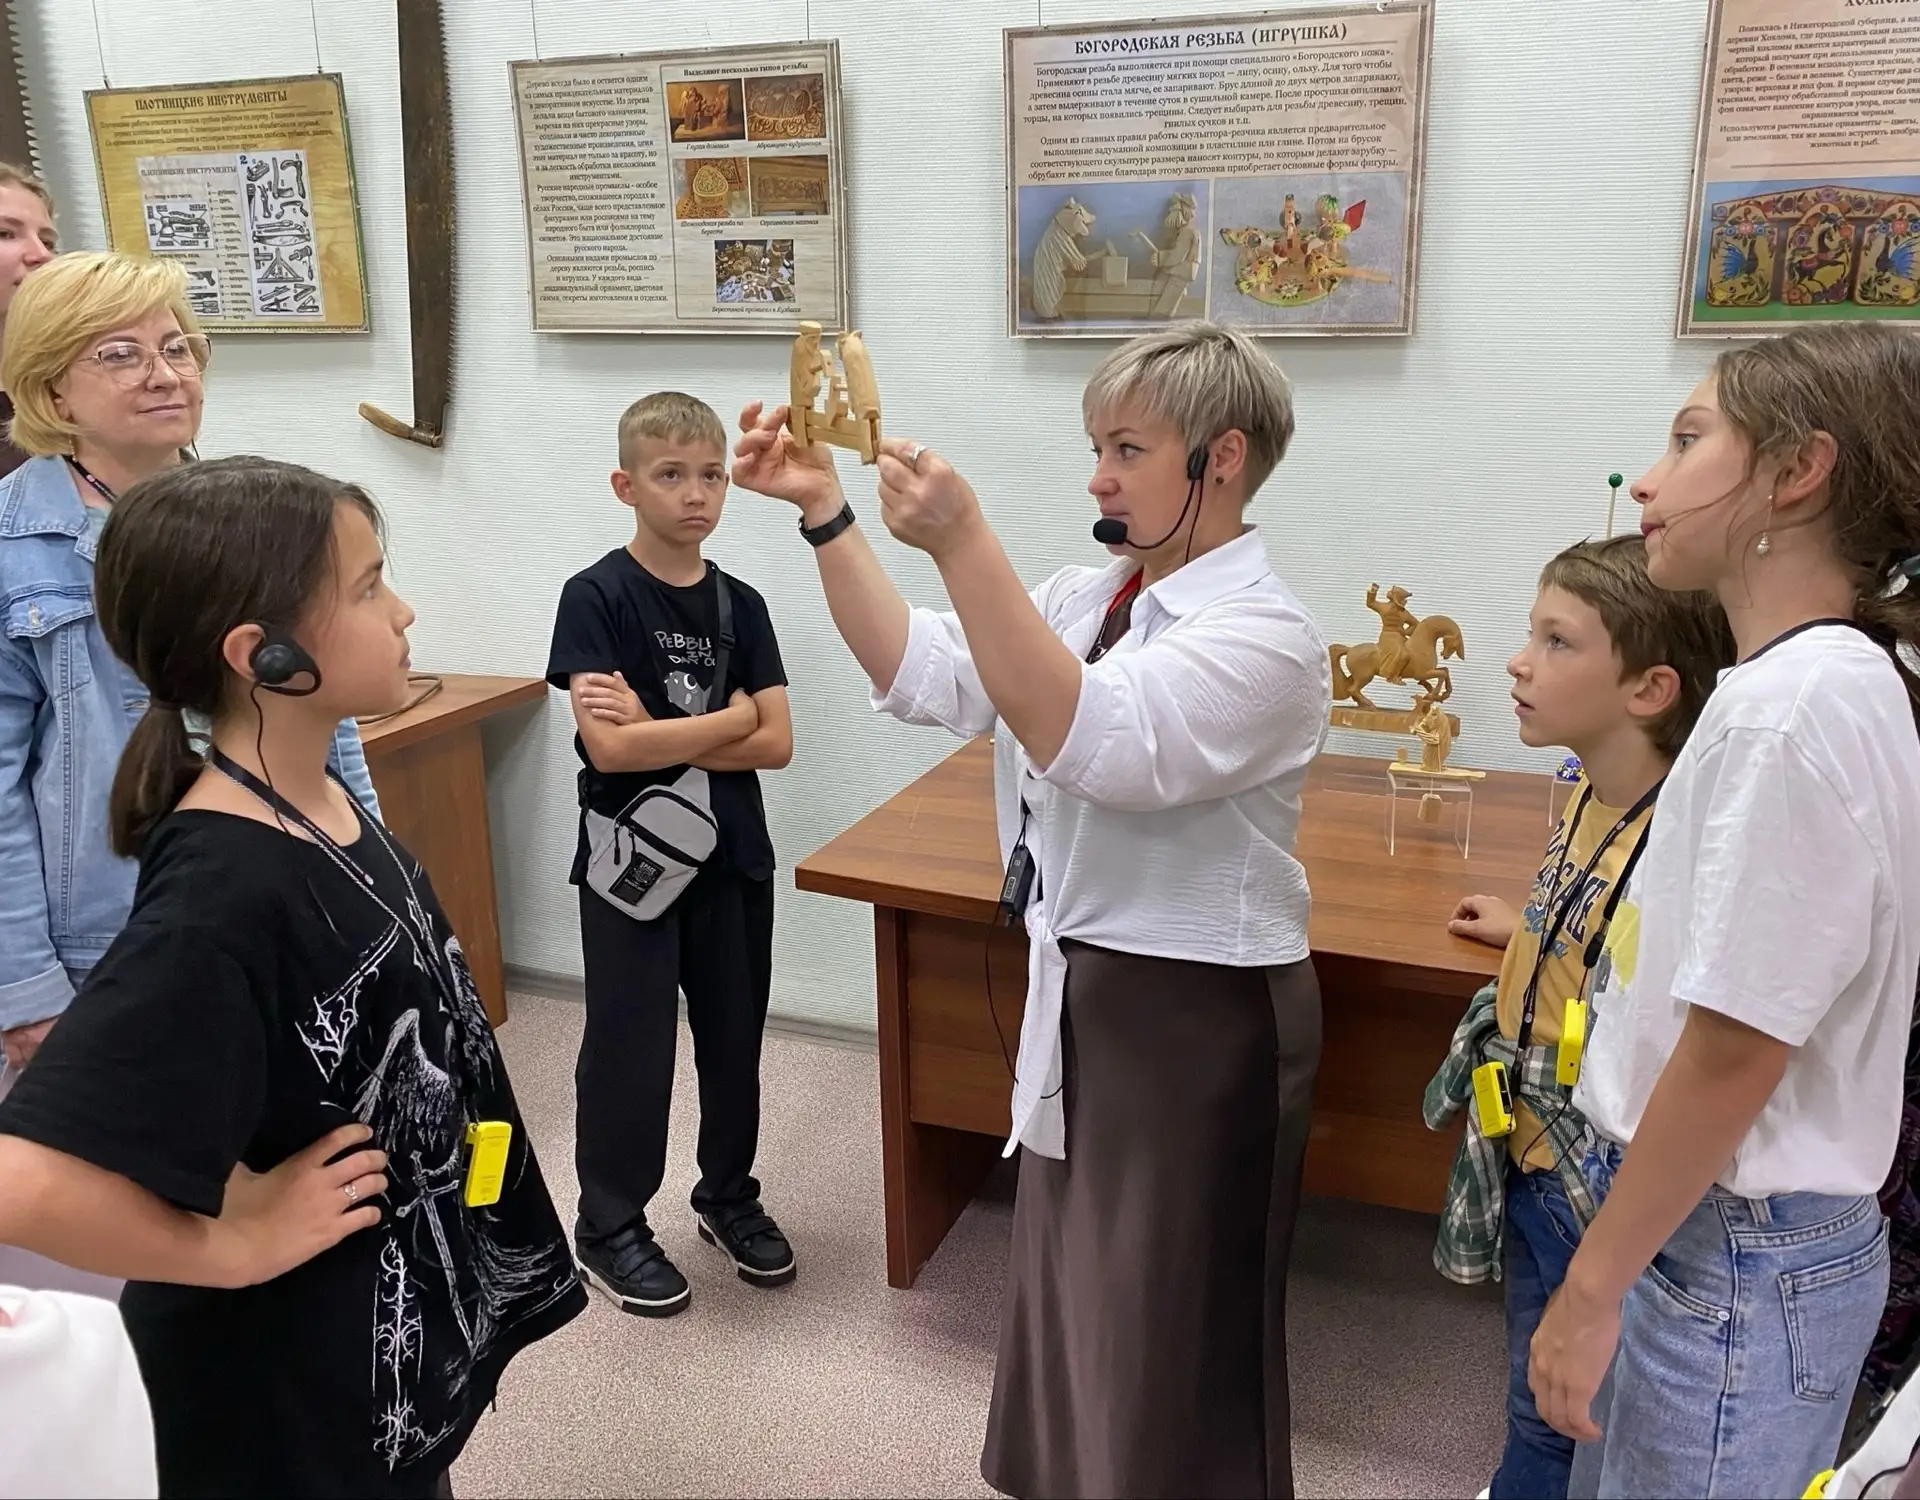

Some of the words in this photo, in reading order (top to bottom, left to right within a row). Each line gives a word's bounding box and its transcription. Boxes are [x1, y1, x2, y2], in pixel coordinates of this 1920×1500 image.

[1074, 35, 1179, 54] БОГОРОДСКАЯ
[1185, 30, 1245, 47] РЕЗЬБА
[1251, 23, 1346, 46] (ИГРУШКА)
[1036, 66, 1087, 76] Богородская
[1088, 62, 1116, 75] резьба
[1117, 62, 1172, 71] выполняется
[1173, 60, 1190, 69] при
[1191, 58, 1228, 67] помощи
[1229, 55, 1290, 66] специального
[1291, 50, 1359, 61] «Богородского
[1360, 48, 1394, 56] ножа».
[1036, 78, 1085, 89] Применяют
[1092, 74, 1120, 86] резьбе
[1121, 74, 1164, 84] древесину
[1166, 72, 1197, 80] мягких
[1198, 70, 1225, 80] пород
[1236, 68, 1260, 77] липу,
[1262, 67, 1290, 76] осину,
[1291, 65, 1320, 74] ольху.
[1321, 62, 1340, 73] Для
[1363, 58, 1392, 68] чтобы
[1029, 91, 1071, 101] древесина
[1071, 89, 1098, 97] осины
[1124, 87, 1151, 95] мягче,
[1163, 83, 1216, 93] запаривают.
[1218, 80, 1239, 91] Брус
[1239, 77, 1273, 90] длиной
[1274, 79, 1285, 88] до
[1286, 78, 1307, 87] двух
[1308, 76, 1341, 85] метров
[1342, 73, 1402, 83] запаривают,
[1058, 100, 1115, 111] выдерживают
[1123, 98, 1157, 106] течение
[1158, 96, 1181, 106] суток
[1189, 91, 1238, 104] сушильной
[1239, 92, 1272, 101] камере.
[1274, 88, 1302, 98] После
[1303, 88, 1349, 98] просушки
[1349, 85, 1402, 94] опиливают
[134, 96, 203, 109] ПЛОТНИЦКИЕ
[206, 91, 289, 105] ИНСТРУМЕНТЫ
[1022, 115, 1050, 124] торцы,
[1063, 113, 1097, 122] которых
[1099, 110, 1143, 119] появились
[1144, 109, 1186, 119] трещины.
[1187, 105, 1222, 116] Следует
[1223, 103, 1265, 114] выбирать
[1266, 103, 1282, 113] для
[1283, 99, 1316, 111] резьбы
[1316, 99, 1366, 110] древесину,
[1368, 98, 1407, 107] трещин,
[1039, 135, 1068, 146] Одним
[1080, 135, 1115, 143] главных
[1116, 134, 1147, 143] правил
[1147, 130, 1178, 142] работы
[1179, 128, 1266, 140] скульптора-резчика
[1266, 126, 1306, 134] является
[1307, 123, 1386, 134] предварительное
[1197, 118, 1226, 128] сучков
[1029, 158, 1102, 168] соответствующего
[1103, 156, 1149, 166] скульптуре
[1150, 155, 1185, 165] размера
[1186, 154, 1221, 162] наносят
[1222, 152, 1261, 162] контуры,
[1276, 150, 1314, 159] которым
[1315, 148, 1349, 158] делают
[1350, 145, 1386, 157] зарубку
[1043, 147, 1093, 156] выполнение
[1094, 143, 1143, 156] задуманной
[1145, 143, 1197, 152] композиции
[1205, 140, 1256, 149] пластилине
[1276, 138, 1304, 146] глине.
[1306, 135, 1336, 144] Потом
[1350, 133, 1382, 145] брусок
[1027, 169, 1065, 181] обрубают
[1114, 166, 1157, 177] благодаря
[1158, 167, 1183, 176] этому
[1183, 165, 1225, 173] заготовка
[1226, 161, 1281, 174] приобретает
[1281, 161, 1325, 169] основные
[1326, 158, 1358, 170] формы
[1360, 157, 1400, 168] фигуры.
